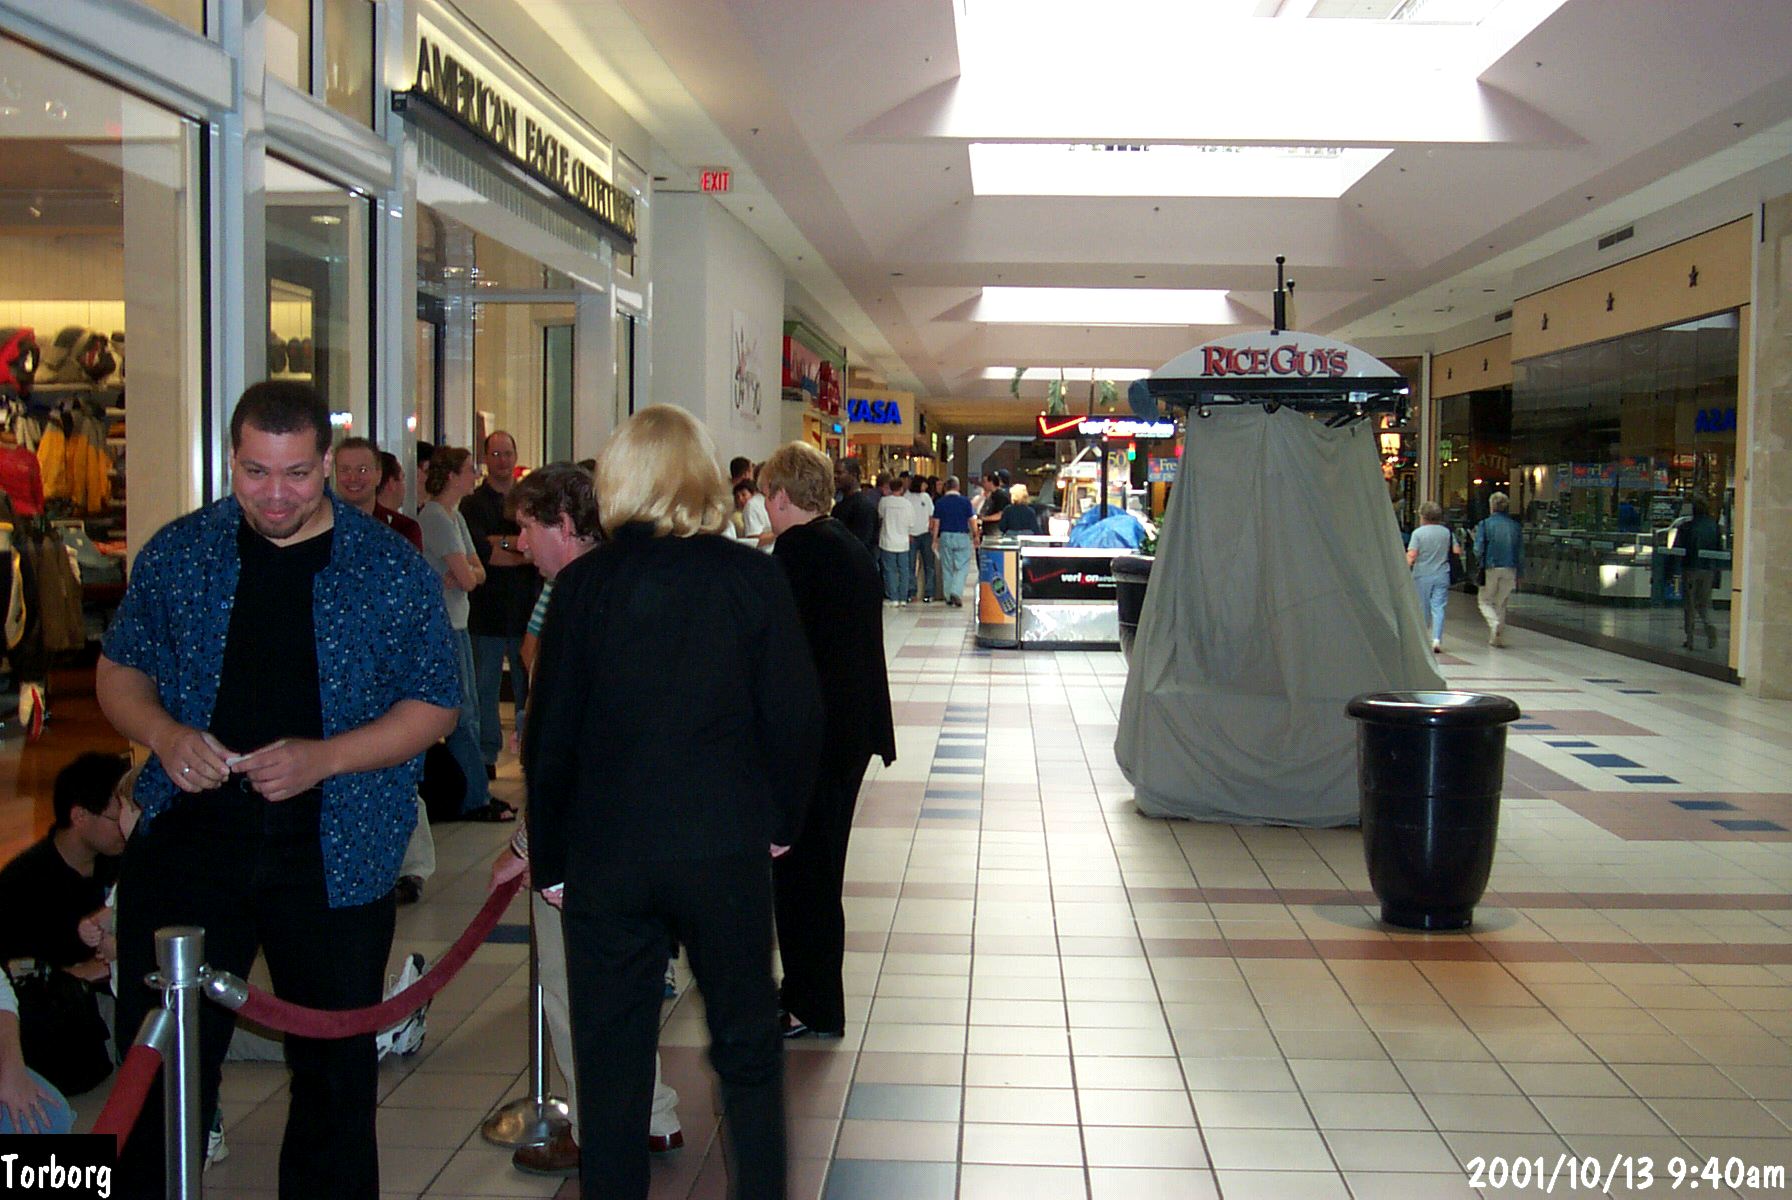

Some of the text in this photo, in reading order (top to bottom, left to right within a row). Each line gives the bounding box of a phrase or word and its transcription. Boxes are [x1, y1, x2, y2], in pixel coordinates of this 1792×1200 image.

[416, 36, 517, 154] AMERICAN
[525, 116, 569, 192] EAGLE
[703, 171, 730, 191] EXIT
